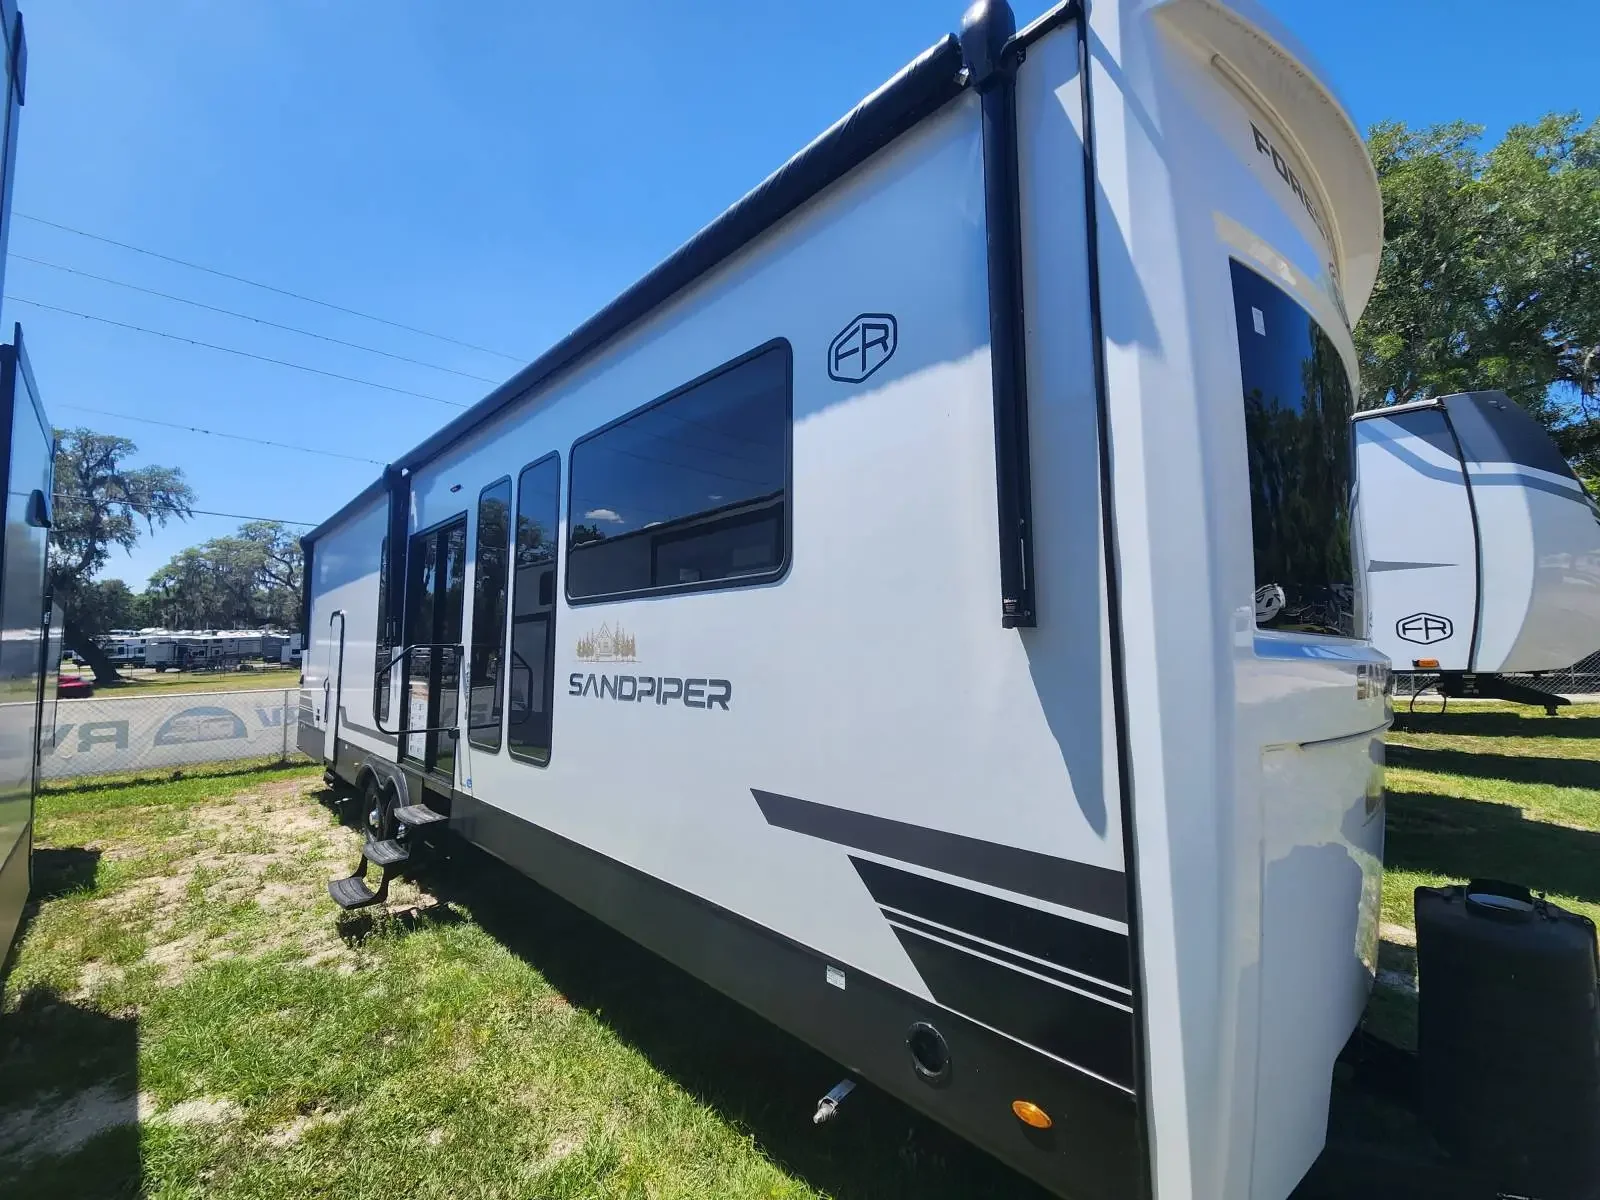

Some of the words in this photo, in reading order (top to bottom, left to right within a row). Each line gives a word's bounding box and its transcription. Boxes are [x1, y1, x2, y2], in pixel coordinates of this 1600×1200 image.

[1249, 119, 1327, 241] FORE
[834, 322, 890, 373] FR
[1401, 616, 1447, 641] FR
[568, 672, 732, 711] SANDPIPER
